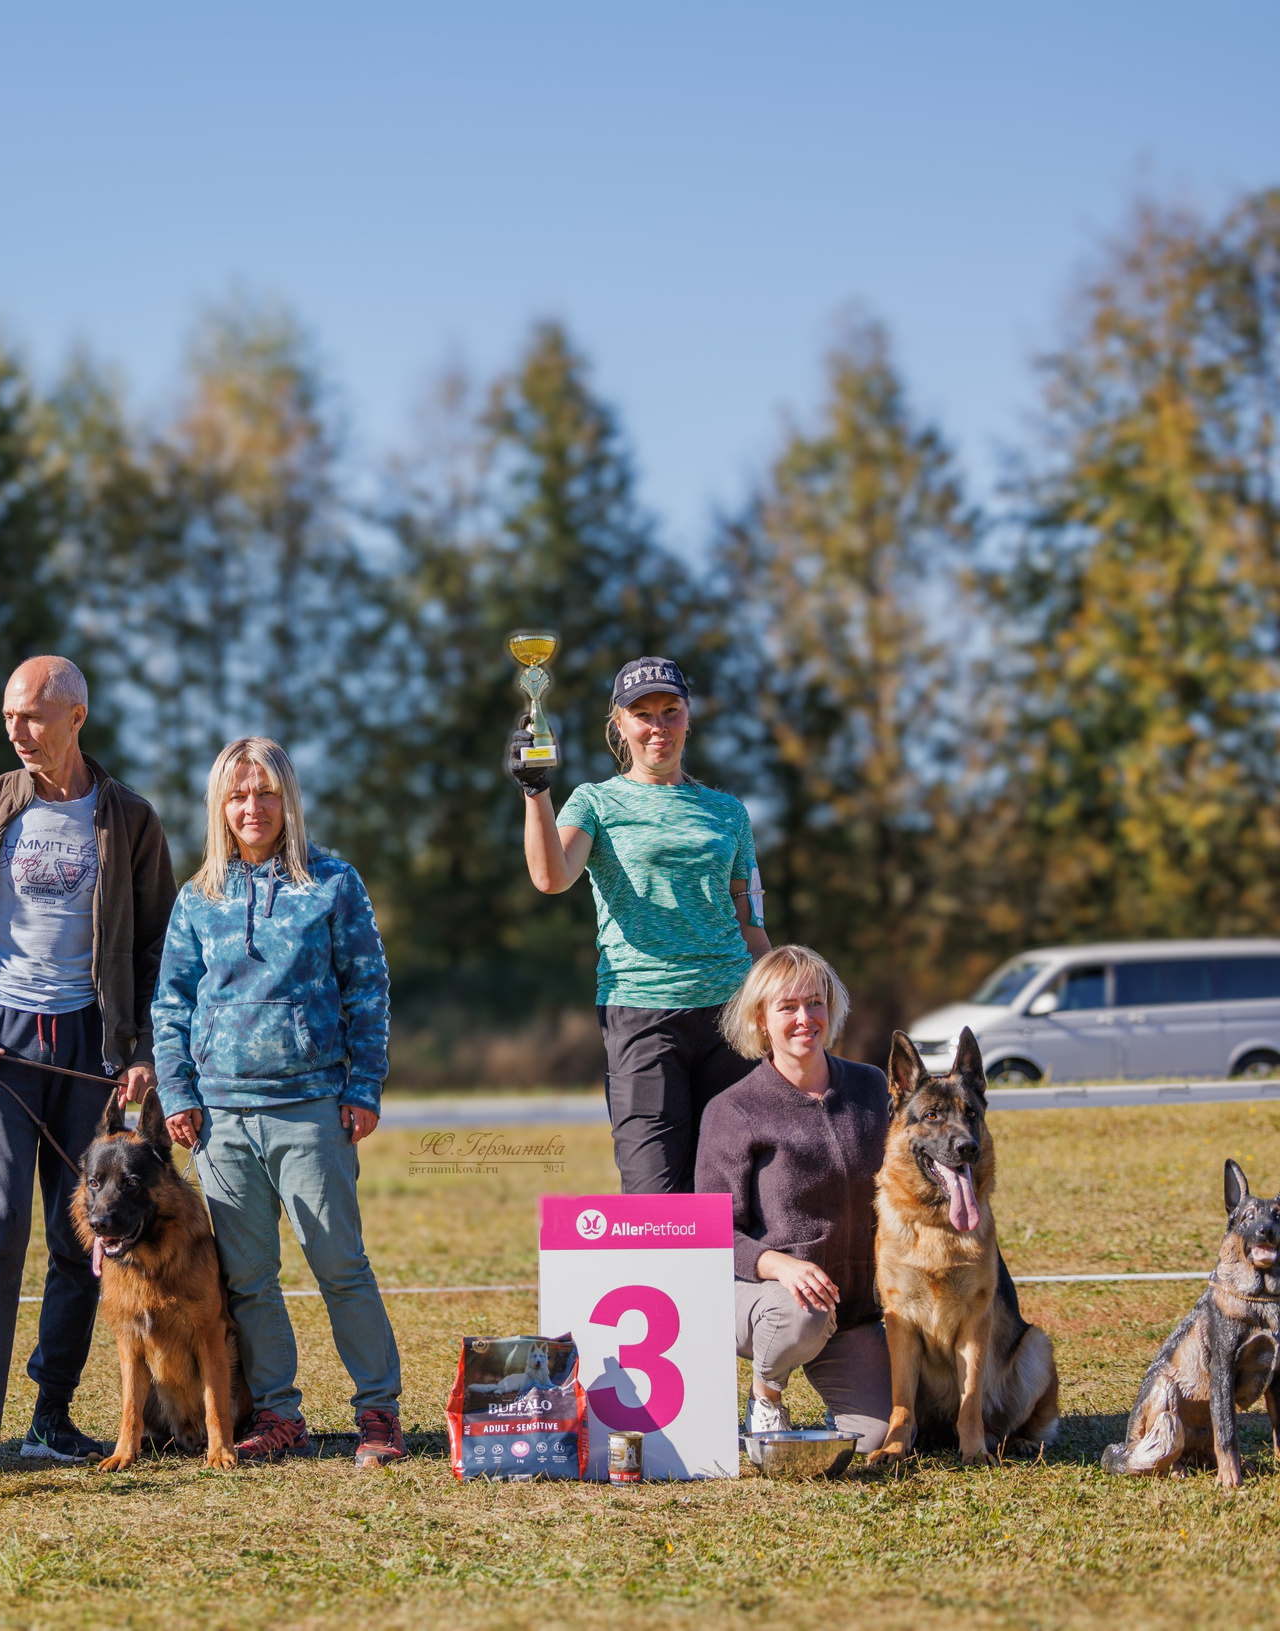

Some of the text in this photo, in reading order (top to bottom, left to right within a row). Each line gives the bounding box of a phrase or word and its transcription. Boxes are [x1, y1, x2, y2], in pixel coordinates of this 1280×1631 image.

[623, 666, 676, 690] STYLE
[610, 1222, 696, 1237] AllerPetfood
[586, 1284, 685, 1434] 3
[488, 1398, 553, 1415] BUFFALO
[483, 1421, 559, 1433] ADULT SENSITIVE
